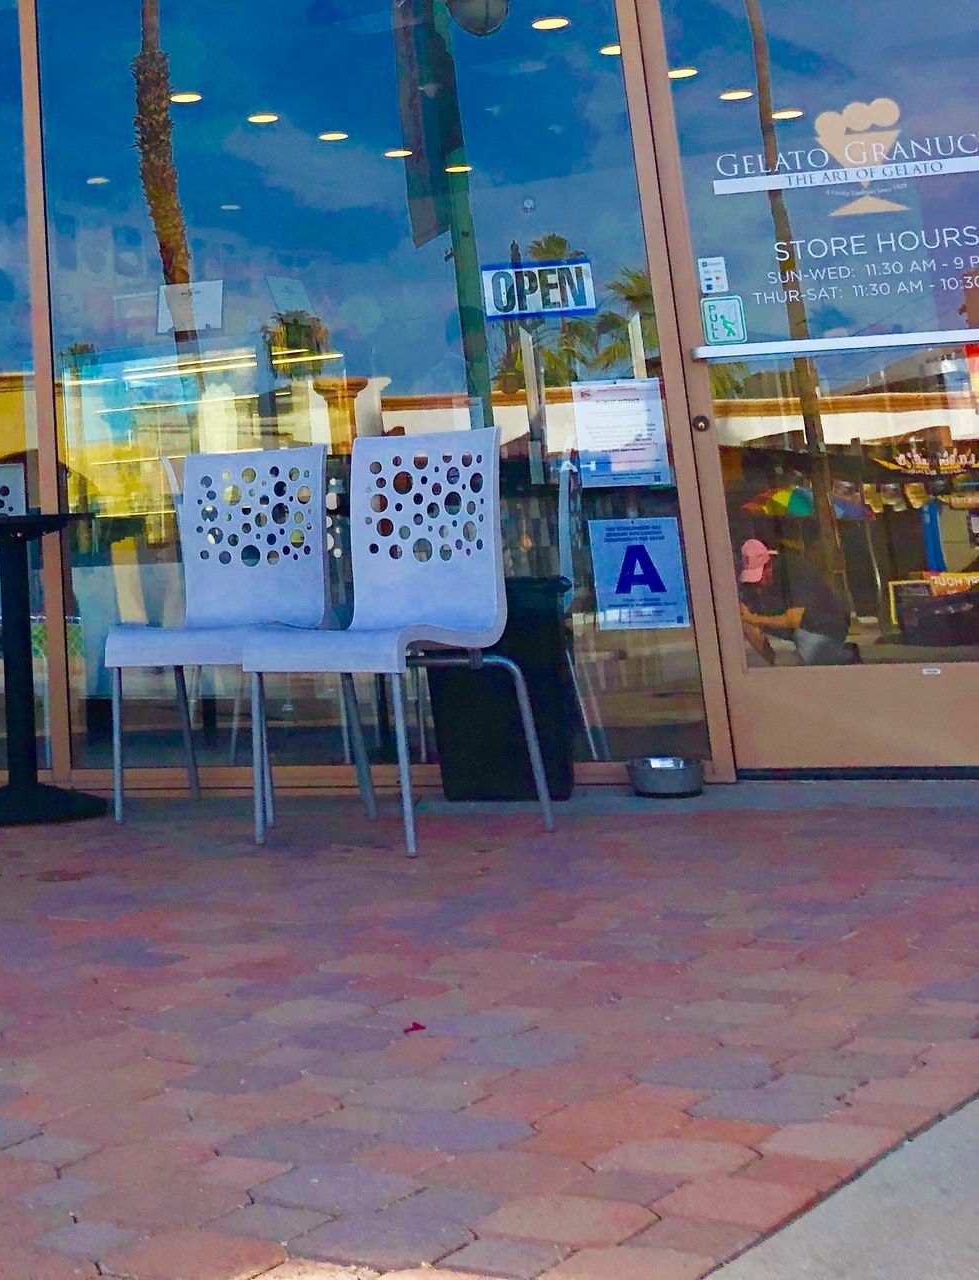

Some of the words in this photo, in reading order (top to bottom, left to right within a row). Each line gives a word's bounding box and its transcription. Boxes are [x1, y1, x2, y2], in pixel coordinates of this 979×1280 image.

[715, 147, 830, 177] GELATO
[785, 172, 817, 187] THE
[822, 169, 850, 184] ART
[856, 166, 876, 180] OF
[882, 160, 943, 177] GELATO
[773, 234, 868, 262] STORE
[876, 225, 979, 254] HOURS
[766, 264, 856, 285] SUN-WED:
[864, 261, 904, 278] 11:30
[909, 258, 937, 273] AM
[953, 256, 965, 270] 9
[491, 265, 588, 313] OPEN
[752, 284, 844, 305] THUR-SAT:
[851, 282, 891, 298] 11:30
[897, 279, 924, 295] AM
[708, 304, 720, 341] PULL
[614, 544, 668, 595] A
